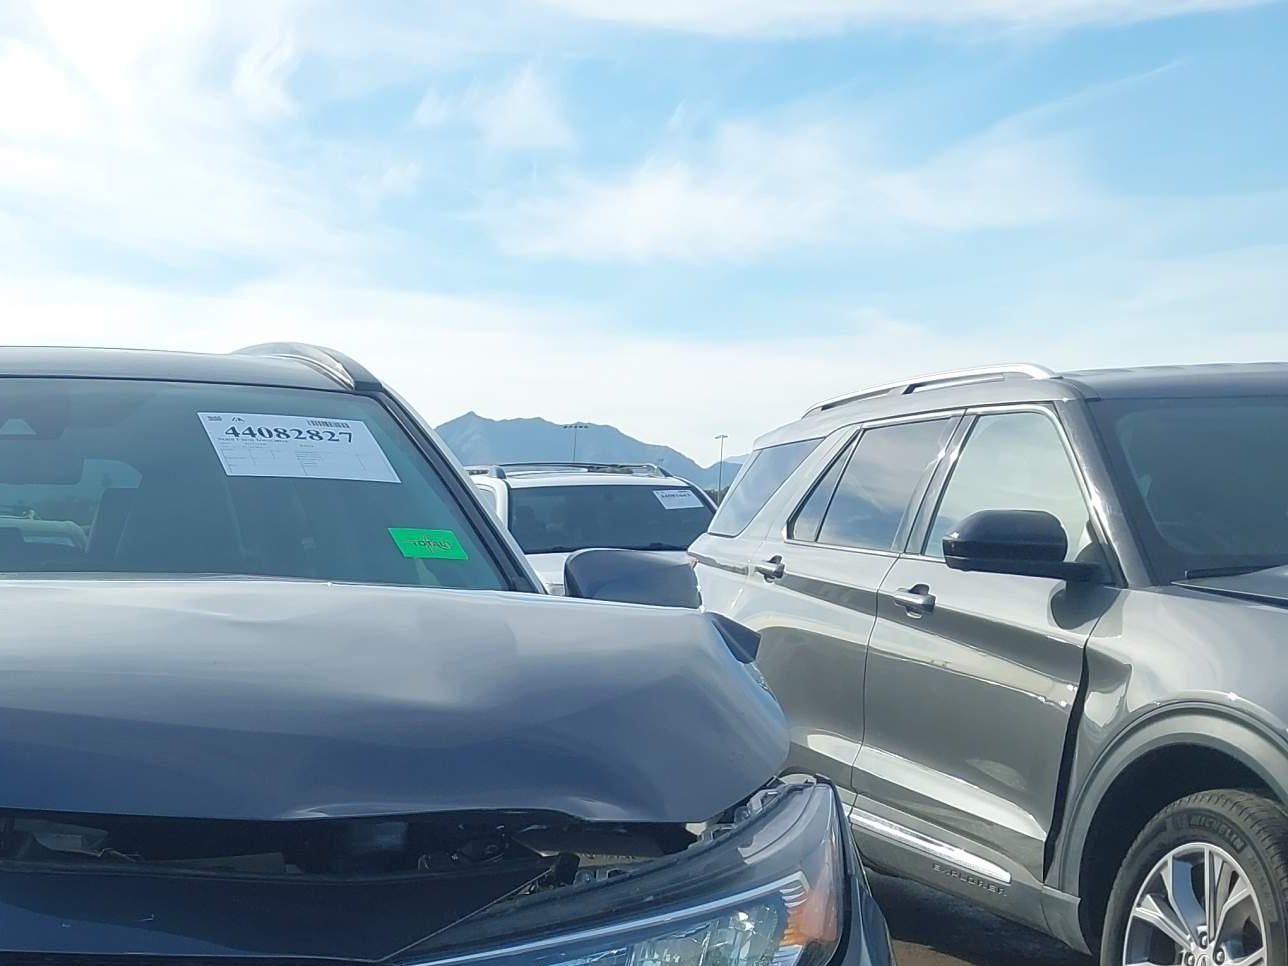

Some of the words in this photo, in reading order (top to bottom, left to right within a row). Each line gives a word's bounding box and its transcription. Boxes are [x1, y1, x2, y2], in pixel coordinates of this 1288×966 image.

[224, 424, 353, 444] 44082827
[1188, 815, 1246, 851] MICHELIN
[932, 863, 1008, 897] EXPLORER
